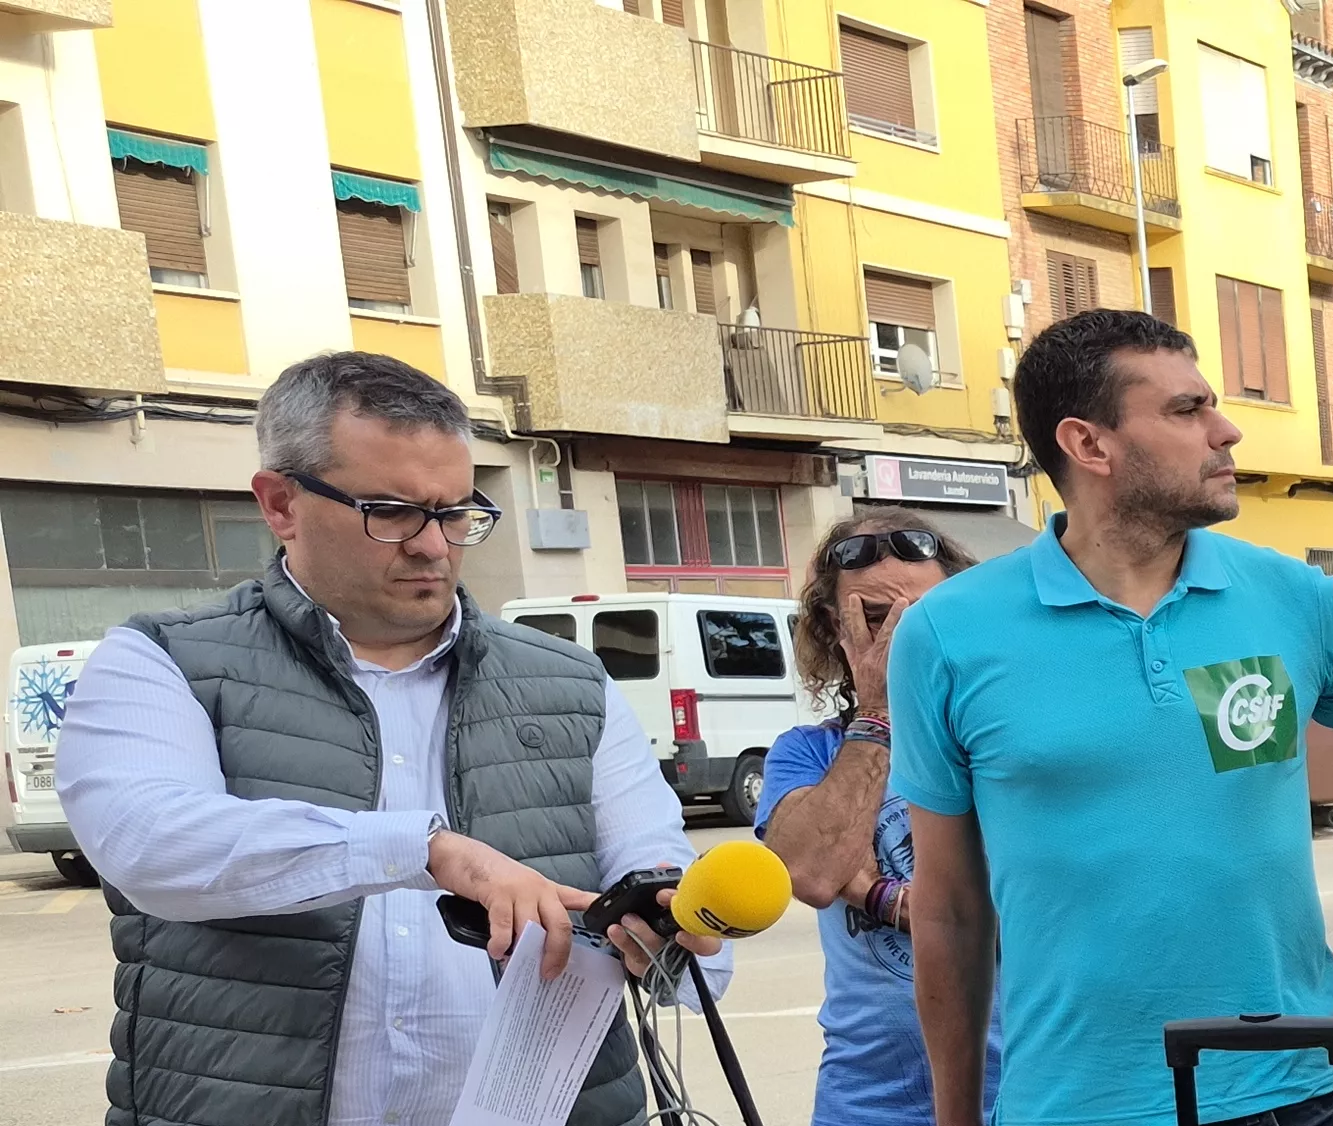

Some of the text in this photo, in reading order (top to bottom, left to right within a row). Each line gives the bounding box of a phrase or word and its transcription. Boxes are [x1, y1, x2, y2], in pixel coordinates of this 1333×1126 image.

[1232, 694, 1284, 726] CSIF
[34, 776, 56, 788] 088
[883, 934, 910, 967] VIVE EL
